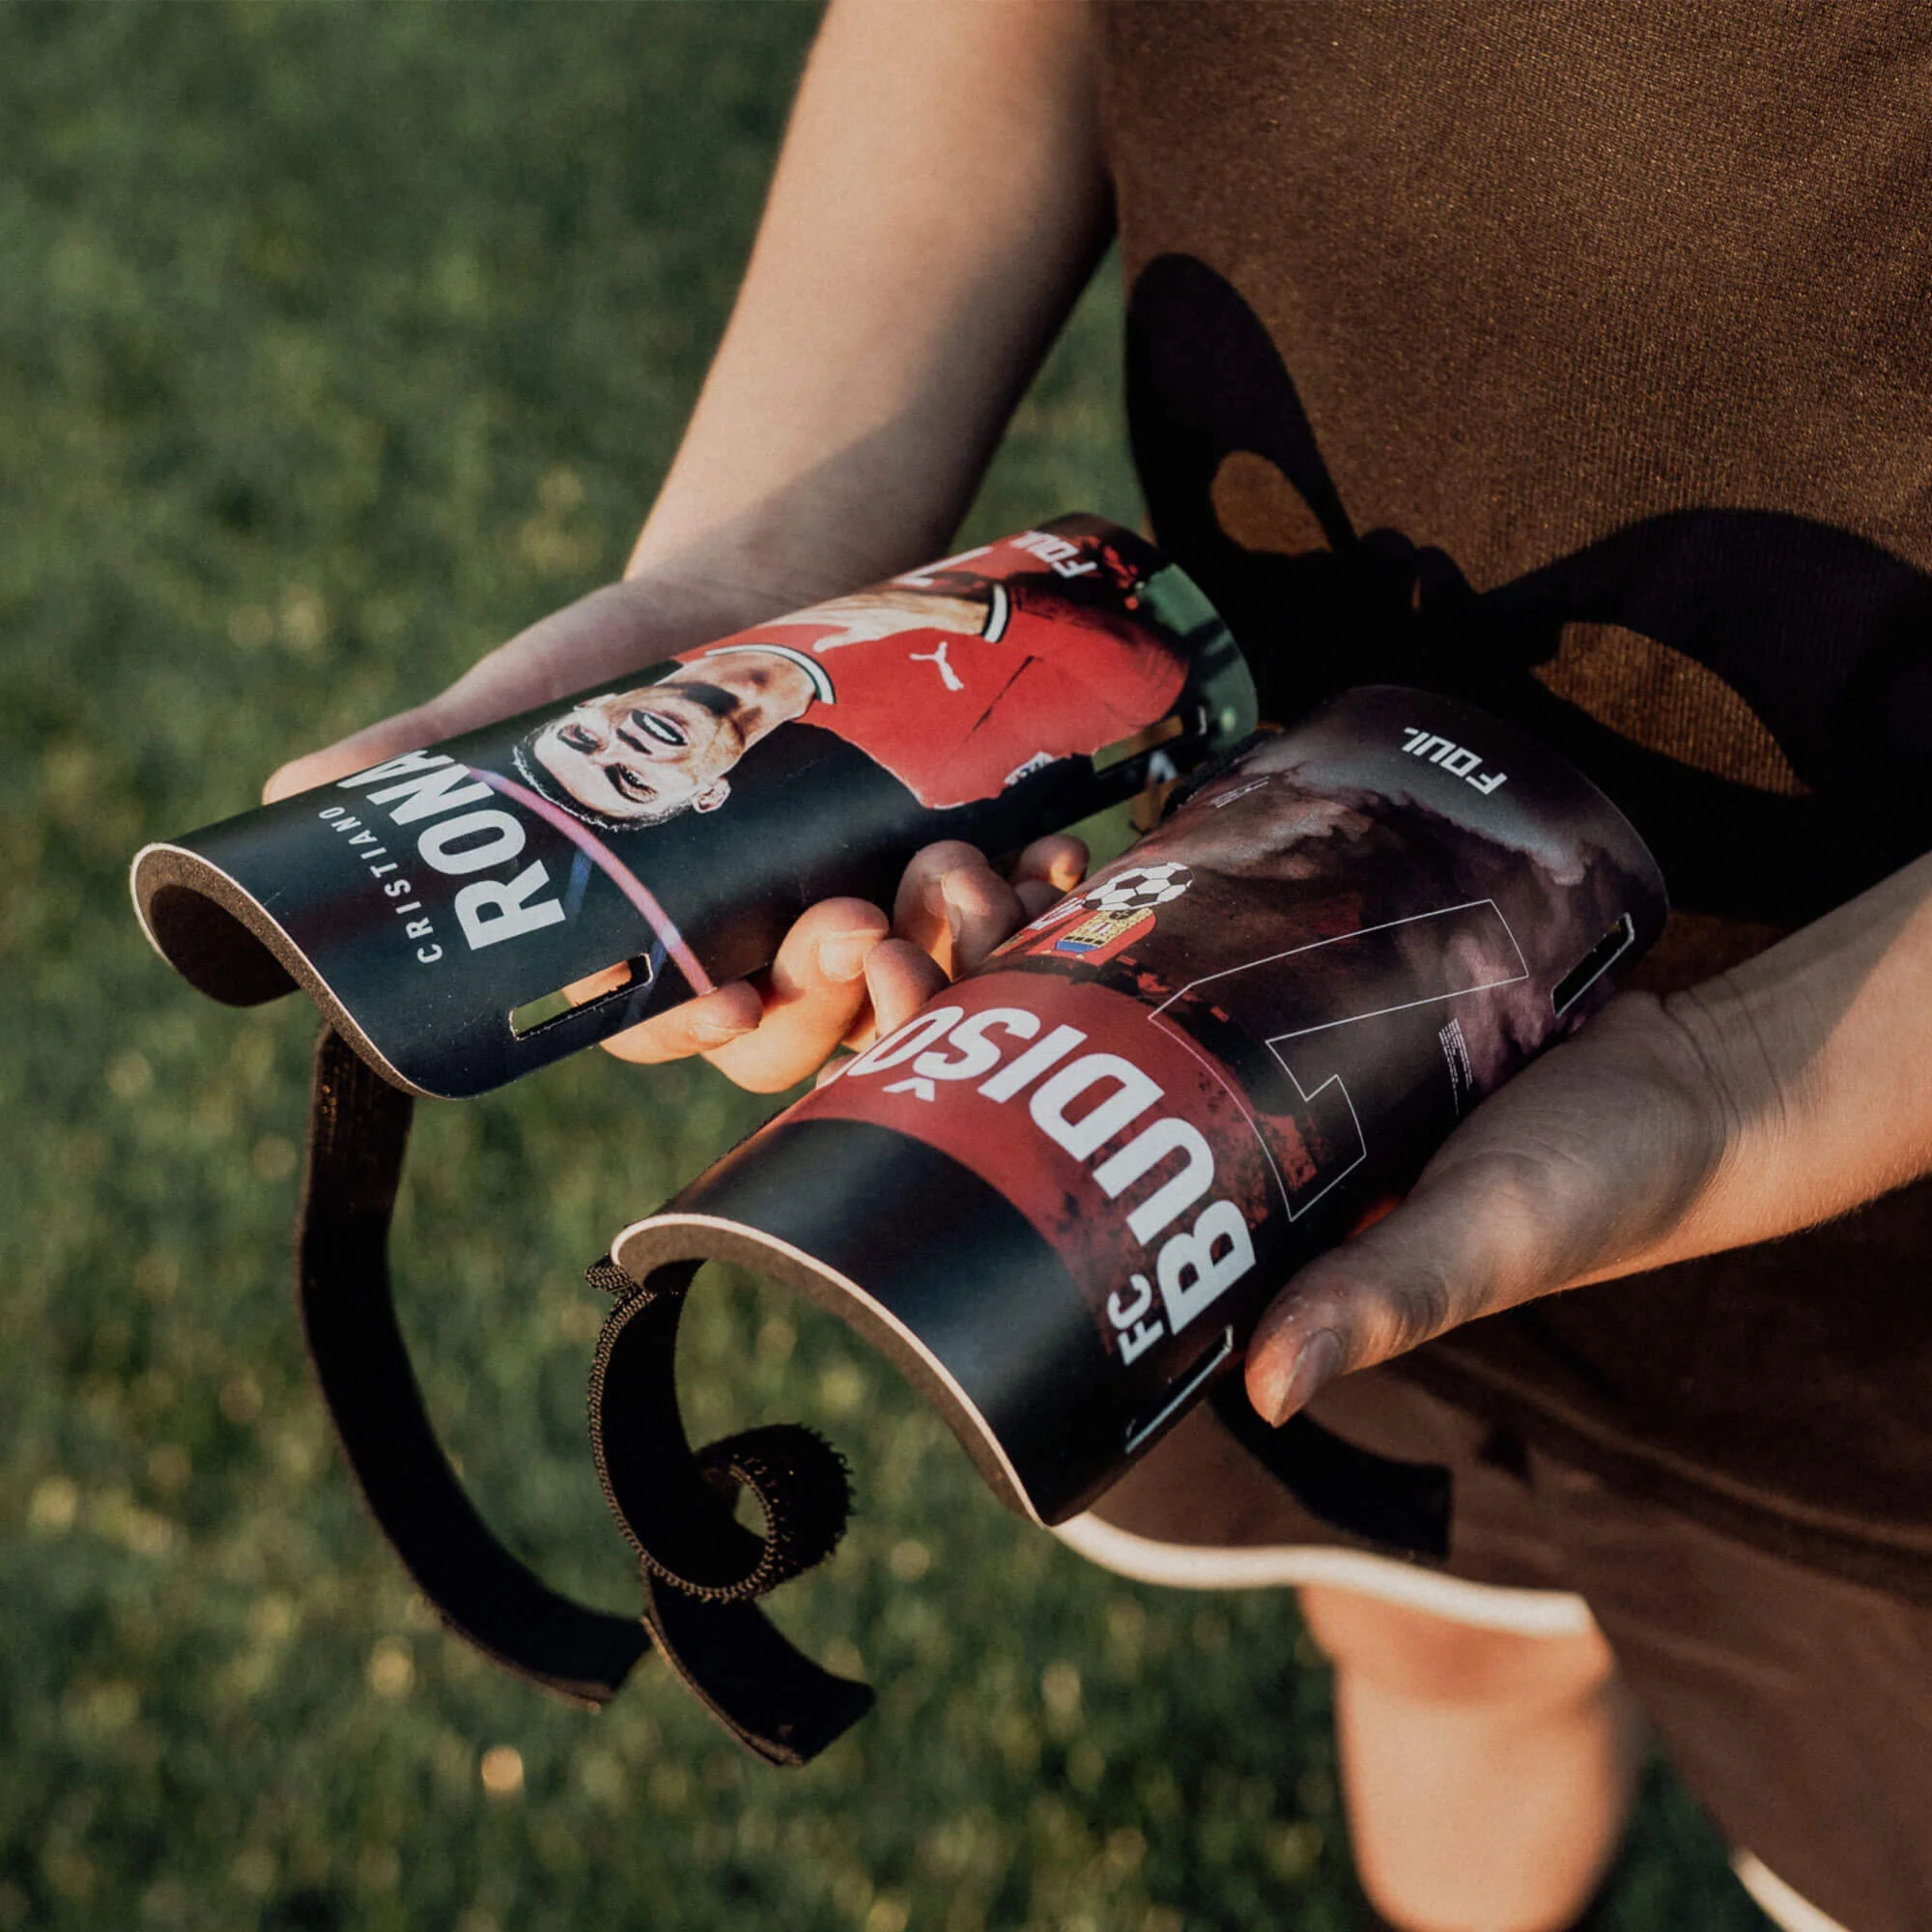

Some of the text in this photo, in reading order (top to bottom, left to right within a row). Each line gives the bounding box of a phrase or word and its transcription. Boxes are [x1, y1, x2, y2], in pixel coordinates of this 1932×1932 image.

[1009, 530, 1097, 578] FOU
[319, 806, 442, 964] CRISTIANO
[336, 749, 566, 951] RONA
[812, 1006, 1256, 1336] BUDIŠO
[1107, 1272, 1165, 1366] FC
